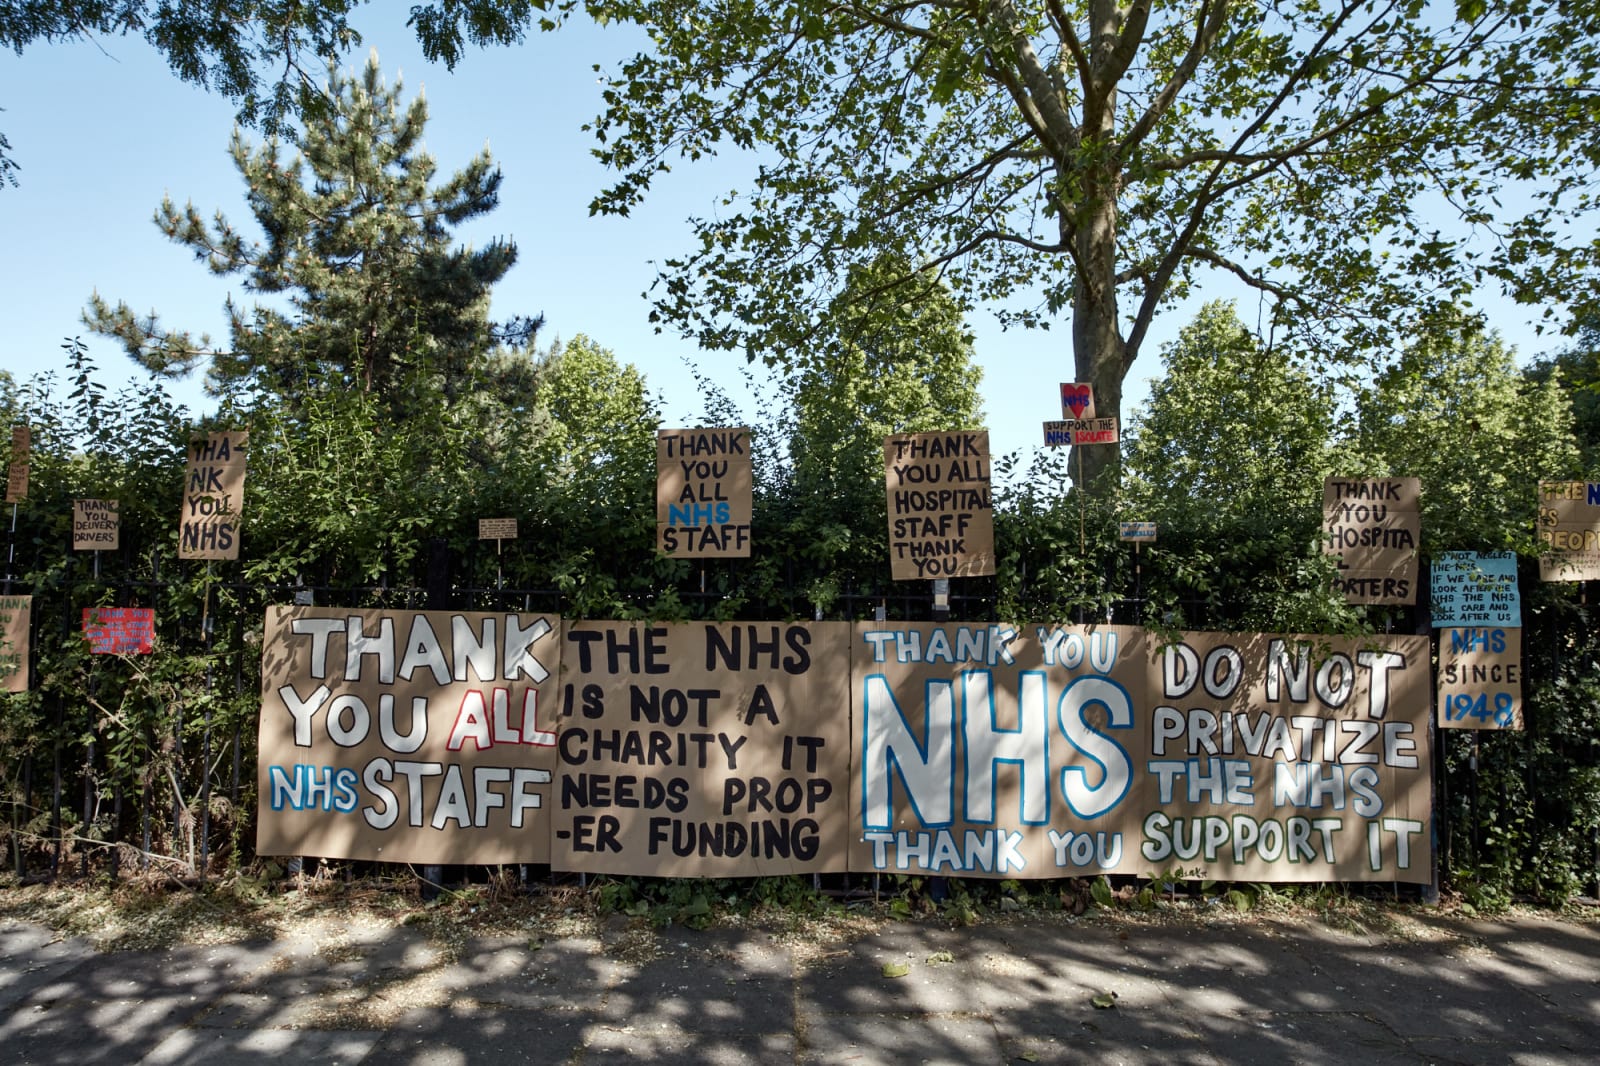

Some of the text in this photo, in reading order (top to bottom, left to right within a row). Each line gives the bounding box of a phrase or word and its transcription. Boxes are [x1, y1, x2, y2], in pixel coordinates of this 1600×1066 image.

[1064, 395, 1089, 407] NHS
[1047, 419, 1114, 431] SUPPORT THE
[662, 432, 743, 458] THANK
[892, 435, 980, 459] THANK
[1047, 431, 1114, 444] NHS ISOLATE
[190, 467, 223, 491] NK
[681, 460, 728, 481] YOU
[893, 460, 991, 486] YOU ALL
[680, 483, 728, 503] ALL
[895, 488, 992, 514] HOSPITAL
[1331, 481, 1402, 501] THANK
[1543, 482, 1584, 500] THE
[76, 501, 115, 511] THANK
[85, 512, 108, 521] YOU
[188, 495, 230, 516] YOU
[668, 502, 730, 526] NHS
[1342, 502, 1386, 523] YOU
[75, 532, 114, 542] DRIVERS
[182, 522, 233, 551] NHS
[894, 514, 972, 538] STAFF
[1329, 526, 1414, 550] HOSPITA
[663, 525, 750, 552] STAFF
[893, 539, 966, 559] THANK
[1541, 530, 1600, 551] PEOP
[912, 557, 957, 577] YOU
[1433, 563, 1450, 572] THE
[1476, 551, 1512, 560] NEGLECT
[1432, 575, 1442, 584] IF
[1447, 575, 1465, 583] WE
[1432, 586, 1457, 594] LOOK
[1432, 593, 1515, 604] NHS THE NHS
[1461, 604, 1485, 612] CARE
[1489, 603, 1509, 611] AND
[1460, 613, 1490, 622] AFTER
[1498, 613, 1511, 621] US
[291, 614, 551, 685] THANK
[567, 625, 811, 675] THE NHS
[864, 624, 1117, 674] THANK YOU
[1451, 629, 1506, 654] NHS
[1162, 638, 1407, 720] DO NOT
[1445, 664, 1518, 684] SINCE
[562, 683, 780, 728] IS NOT A
[1445, 692, 1513, 727] 1948
[279, 684, 556, 752] YOU ALL
[862, 669, 1134, 830] NHS
[1152, 706, 1419, 769] PRIVATIZE
[560, 728, 825, 773] CHARITY IT
[269, 757, 552, 830] NHS STAFF
[561, 773, 832, 816] NEEDS PROP
[1148, 757, 1384, 818] THE NHS
[556, 815, 820, 861] -ER FUNDING
[1141, 812, 1422, 872] SUPPORT IT
[864, 829, 1122, 873] THANK YOU
